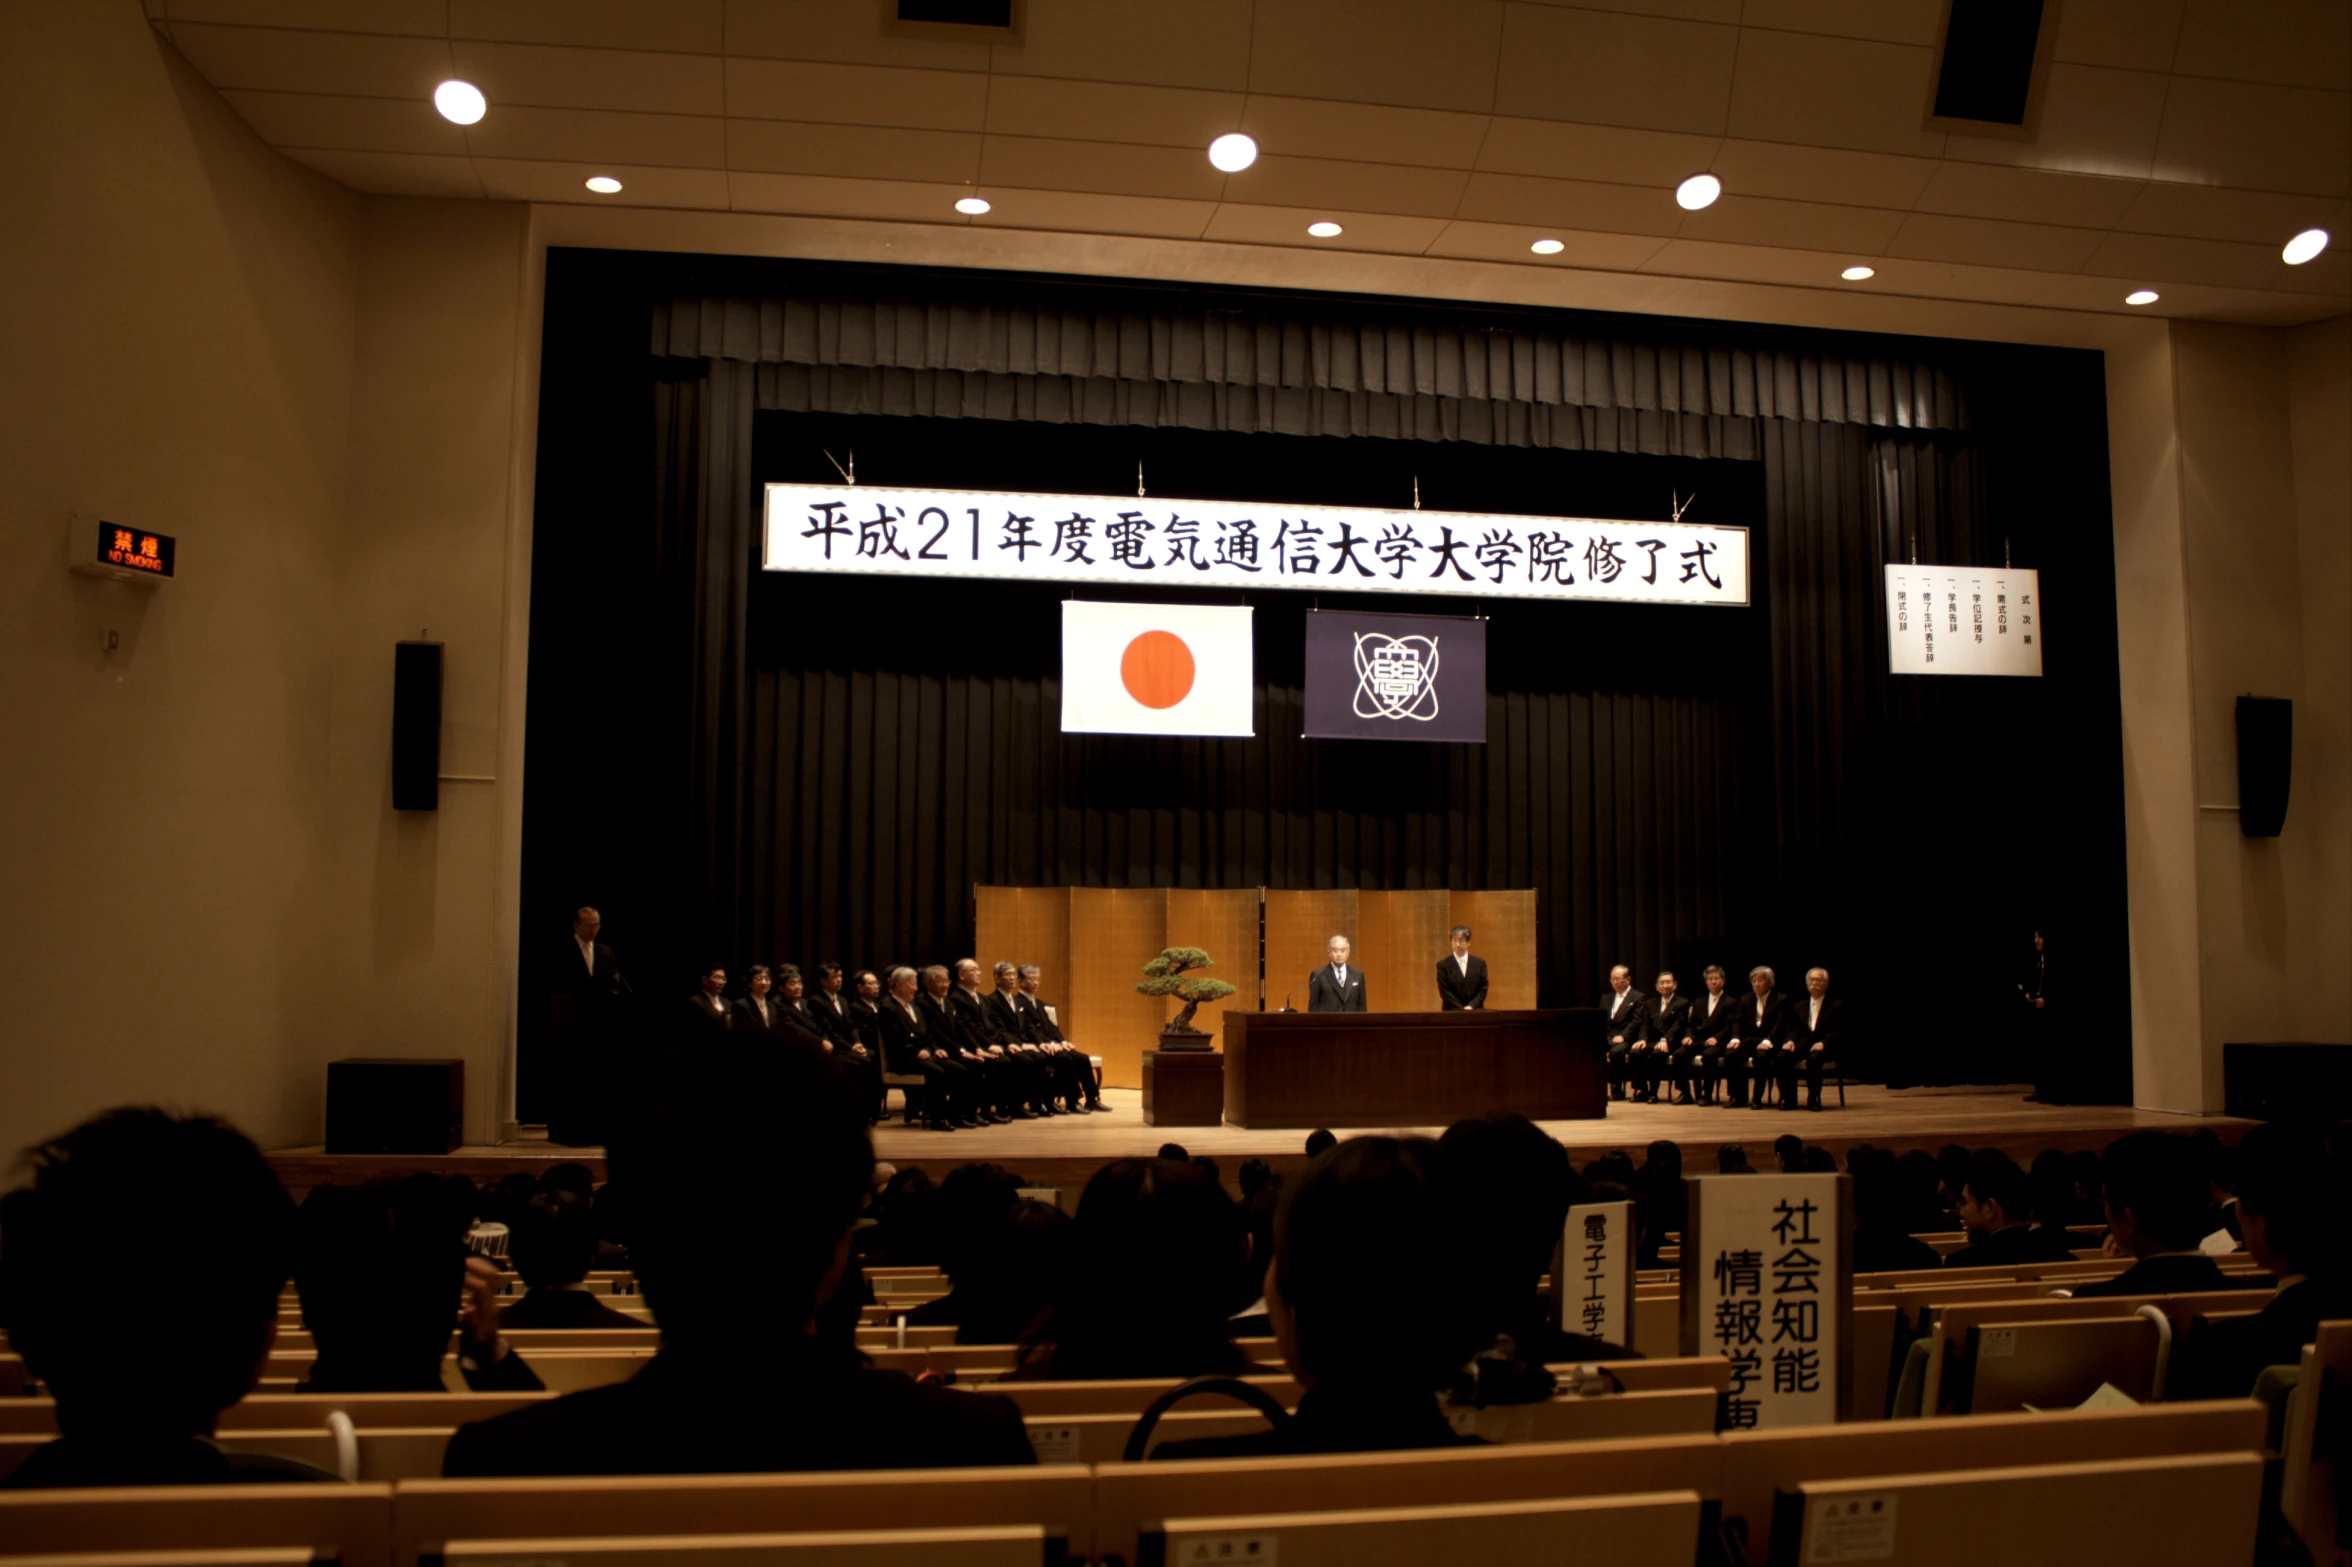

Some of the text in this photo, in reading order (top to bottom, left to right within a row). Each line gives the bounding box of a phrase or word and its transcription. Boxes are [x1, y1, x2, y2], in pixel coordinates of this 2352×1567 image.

[108, 550, 162, 571] NO SMOKING
[115, 530, 158, 558] 禁煙
[800, 503, 1722, 589] 平成21年度電気通信大学大学院修了式
[1972, 579, 1983, 644] 一、学位記授与
[2022, 595, 2032, 645] 式次第
[1582, 1214, 1607, 1344] 電子工学
[1771, 1199, 1821, 1393] 社会知能
